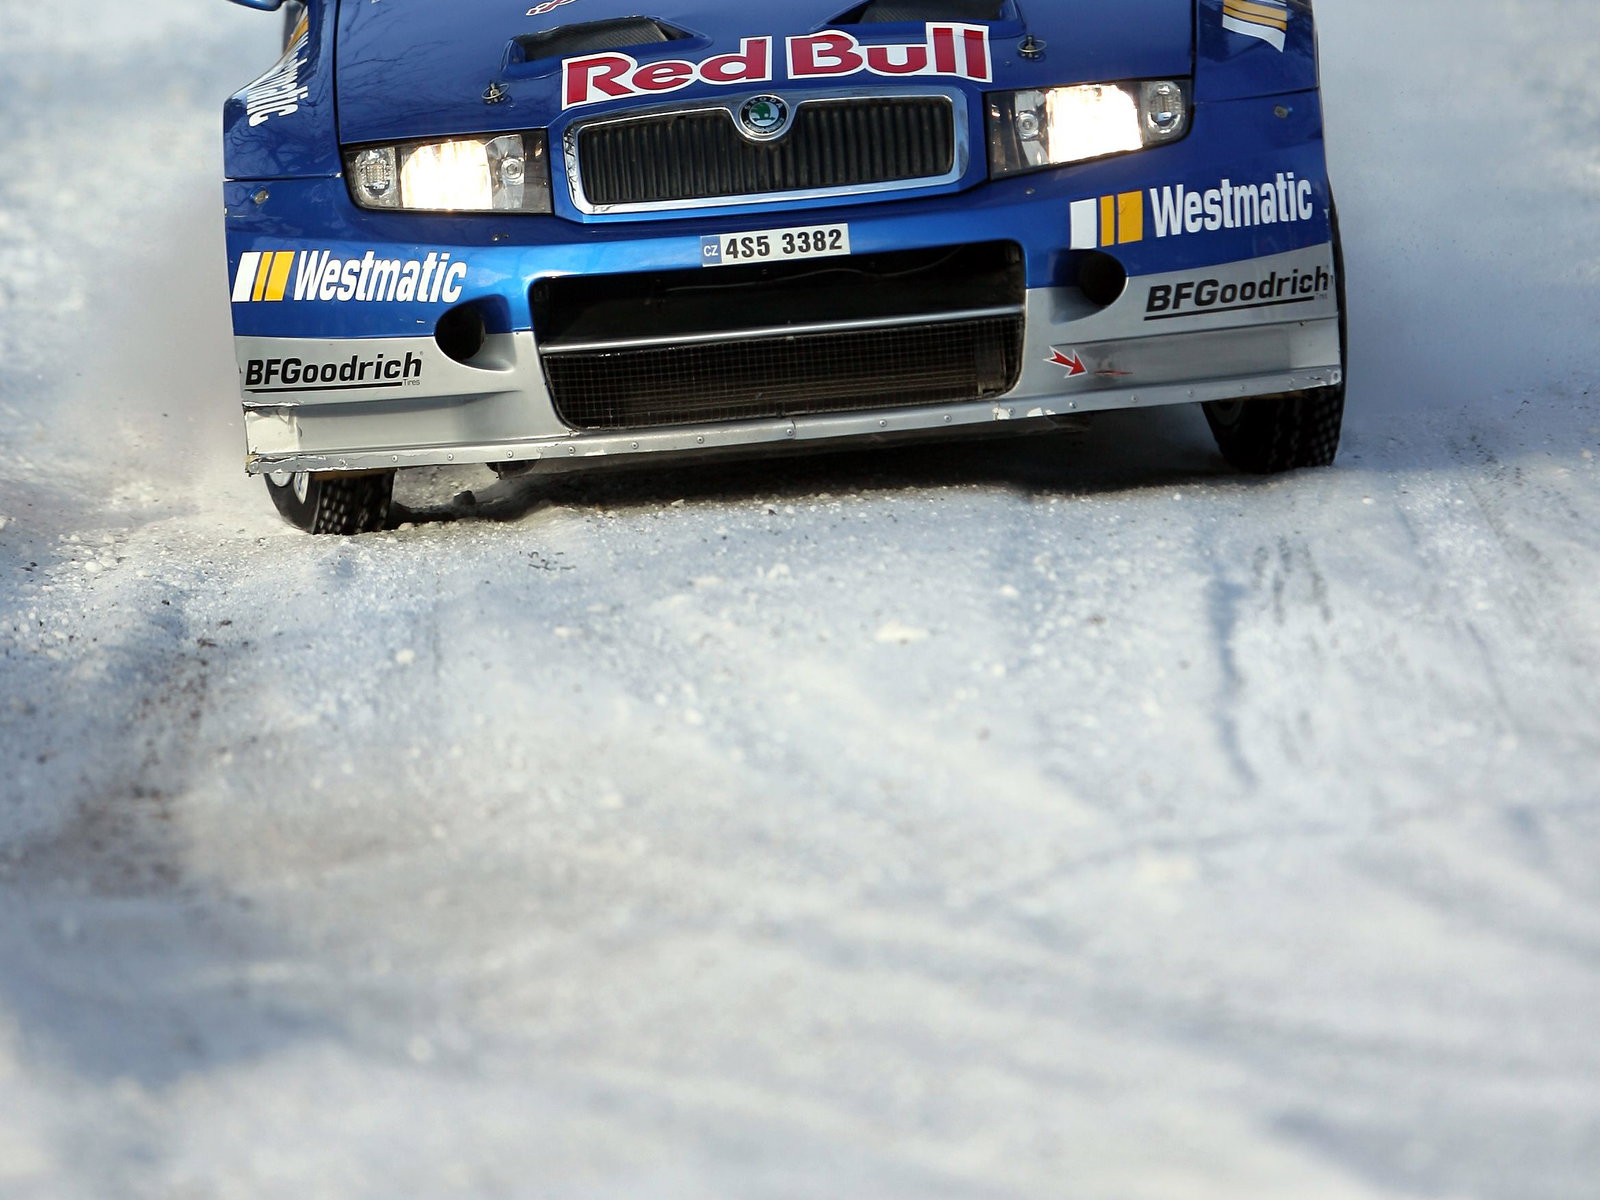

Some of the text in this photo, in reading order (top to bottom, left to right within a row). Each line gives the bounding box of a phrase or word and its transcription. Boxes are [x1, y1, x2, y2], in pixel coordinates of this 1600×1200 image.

[246, 31, 309, 128] tmatic
[561, 21, 993, 110] Red Bull
[1149, 172, 1313, 238] Westmatic
[703, 229, 843, 259] CZ 4S5 3382
[293, 250, 467, 303] Westmatic
[1145, 265, 1329, 313] BFGoodrich
[245, 351, 423, 386] BFGoodrich
